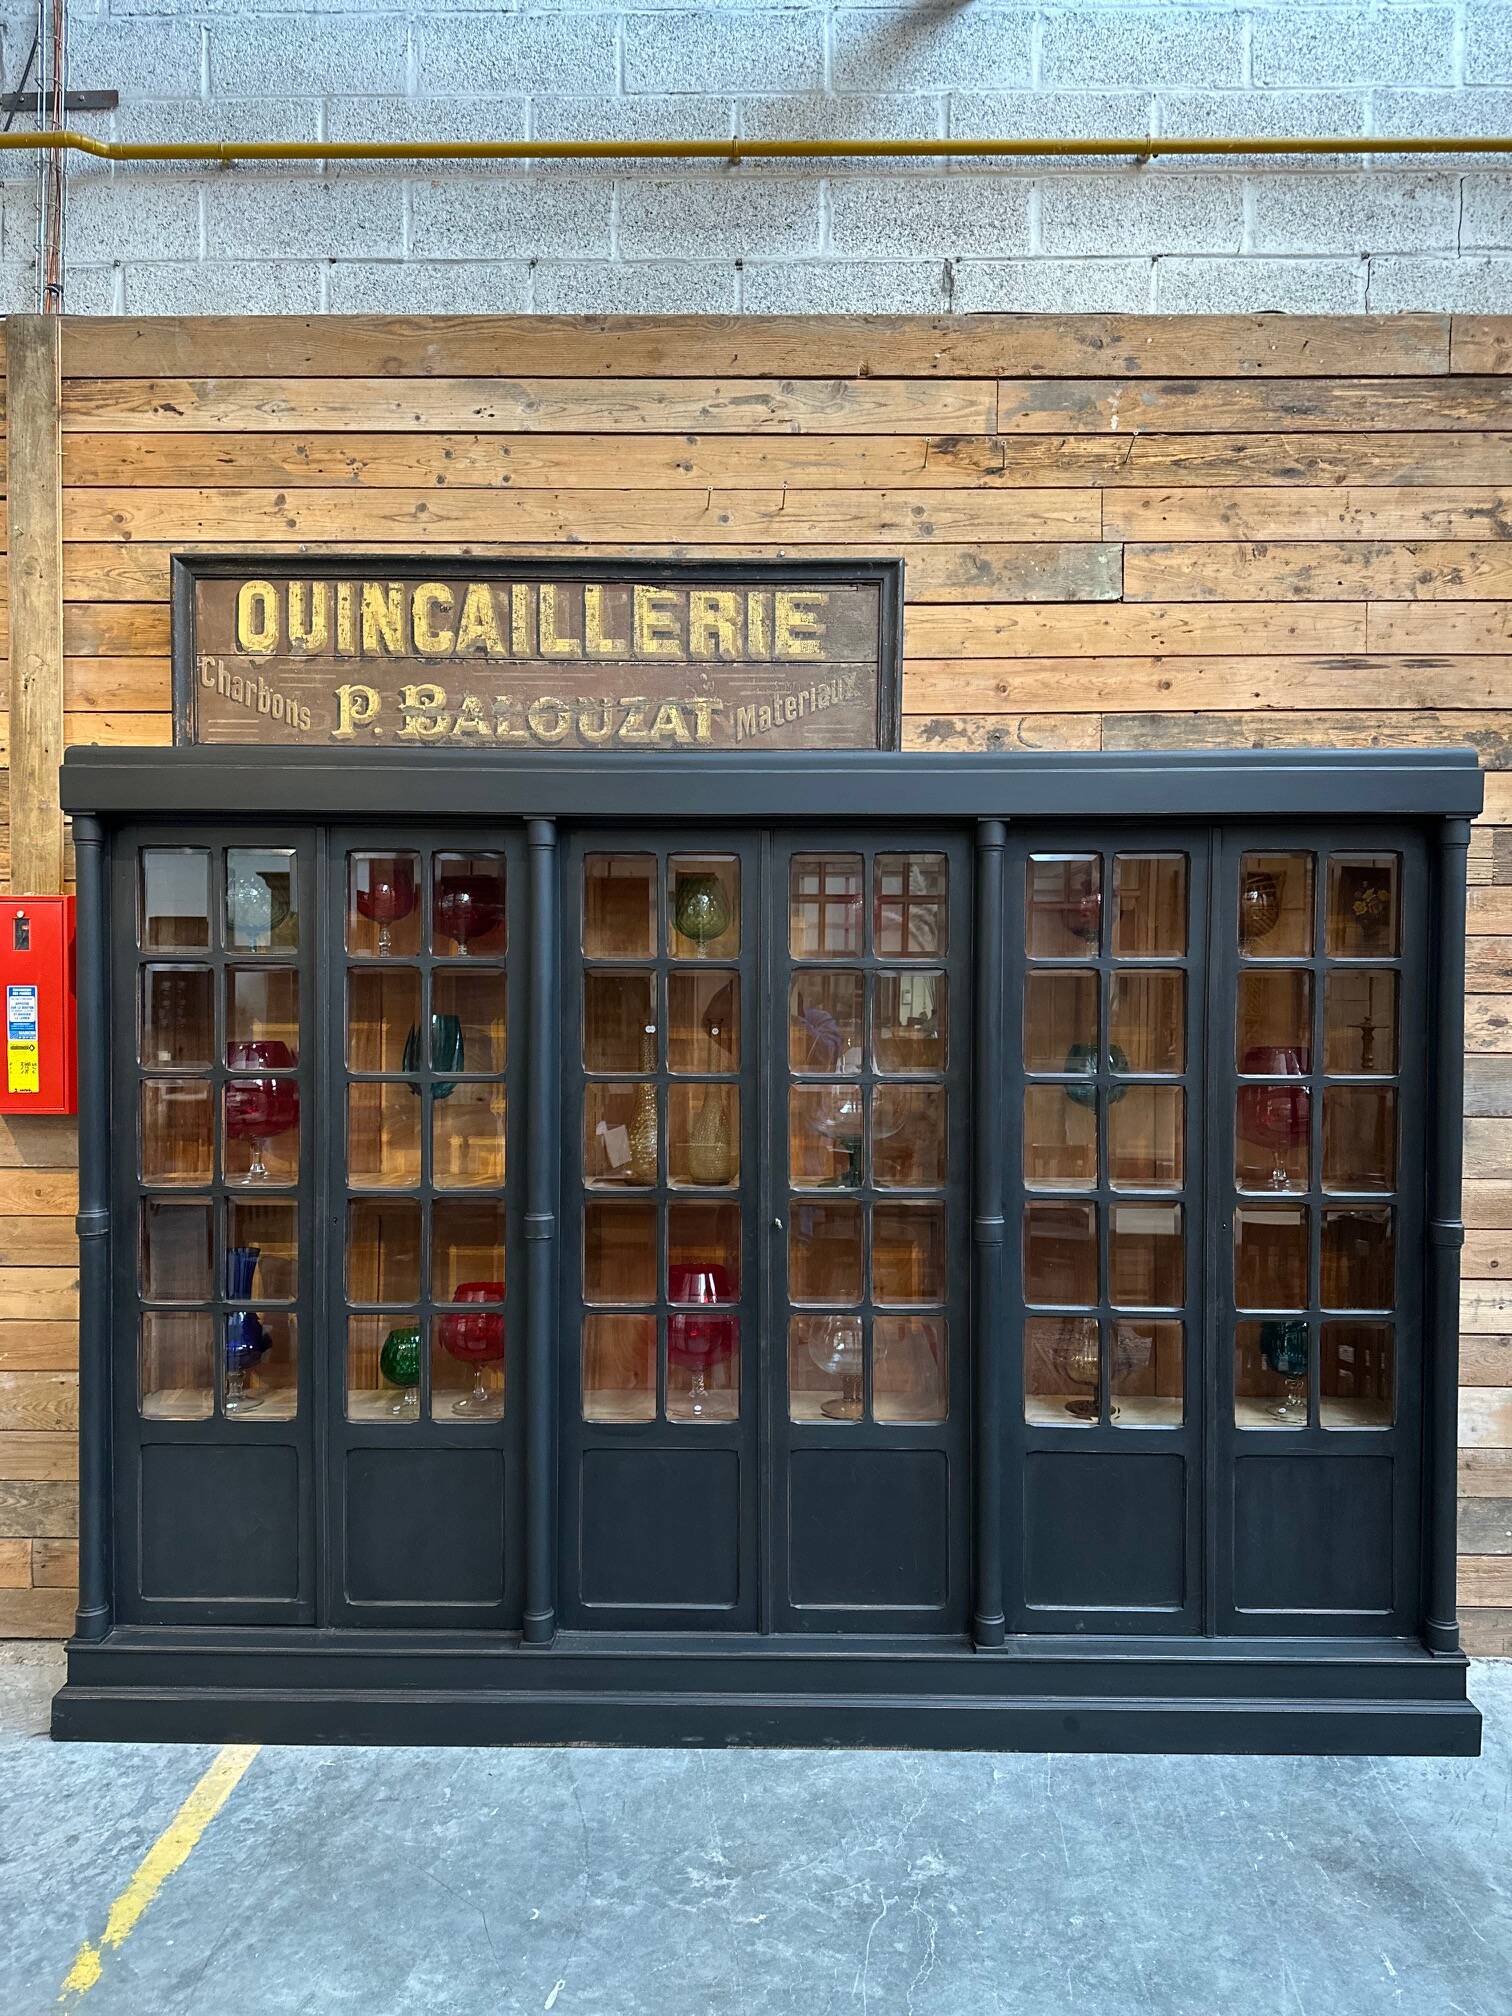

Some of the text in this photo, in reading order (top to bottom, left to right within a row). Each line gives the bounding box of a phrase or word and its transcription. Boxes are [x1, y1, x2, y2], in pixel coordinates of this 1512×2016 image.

[236, 580, 829, 662] QUINCAILLERIE
[199, 654, 312, 731] Charbons
[329, 684, 383, 741] P.
